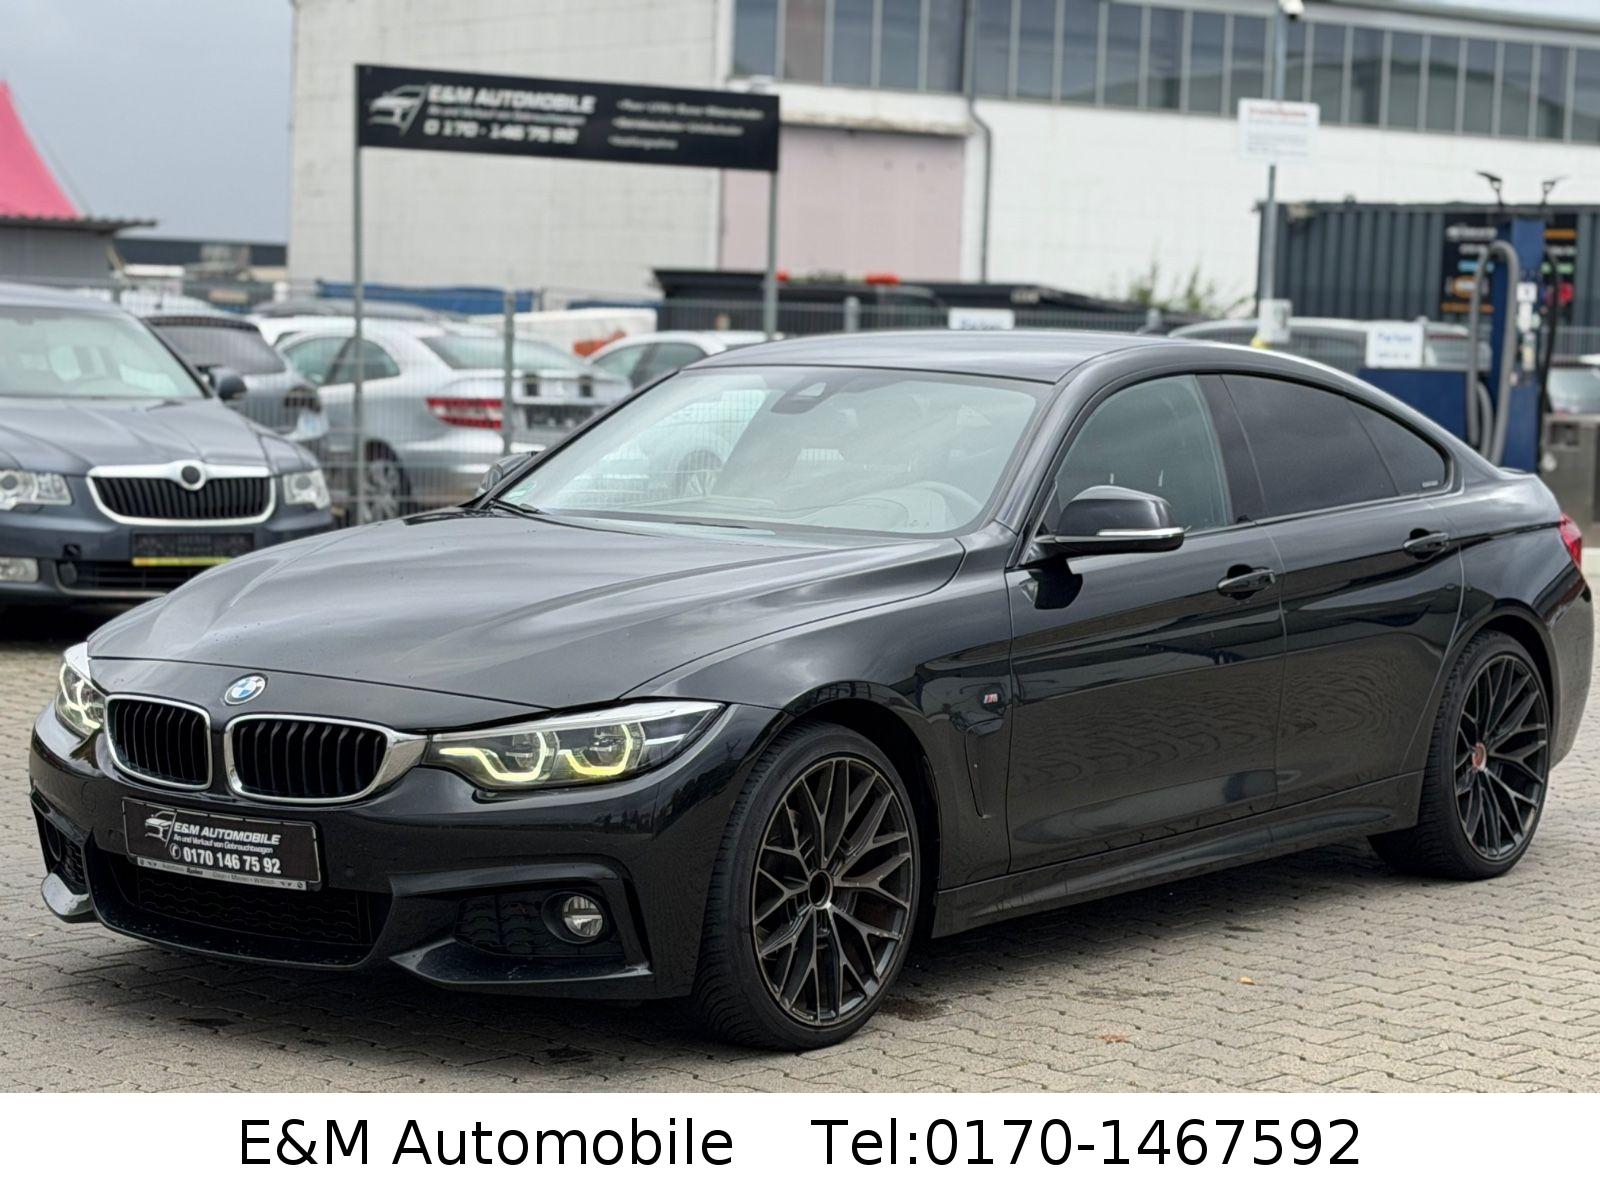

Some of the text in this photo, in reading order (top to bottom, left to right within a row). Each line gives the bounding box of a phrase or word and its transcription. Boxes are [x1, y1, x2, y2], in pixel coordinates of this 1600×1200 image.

[474, 87, 597, 114] AUTOMOBILE
[174, 822, 281, 845] E&M AUTOMOBILE
[183, 846, 214, 866] 0170
[216, 851, 241, 870] 146
[242, 855, 260, 873] 75
[262, 857, 282, 875] 92
